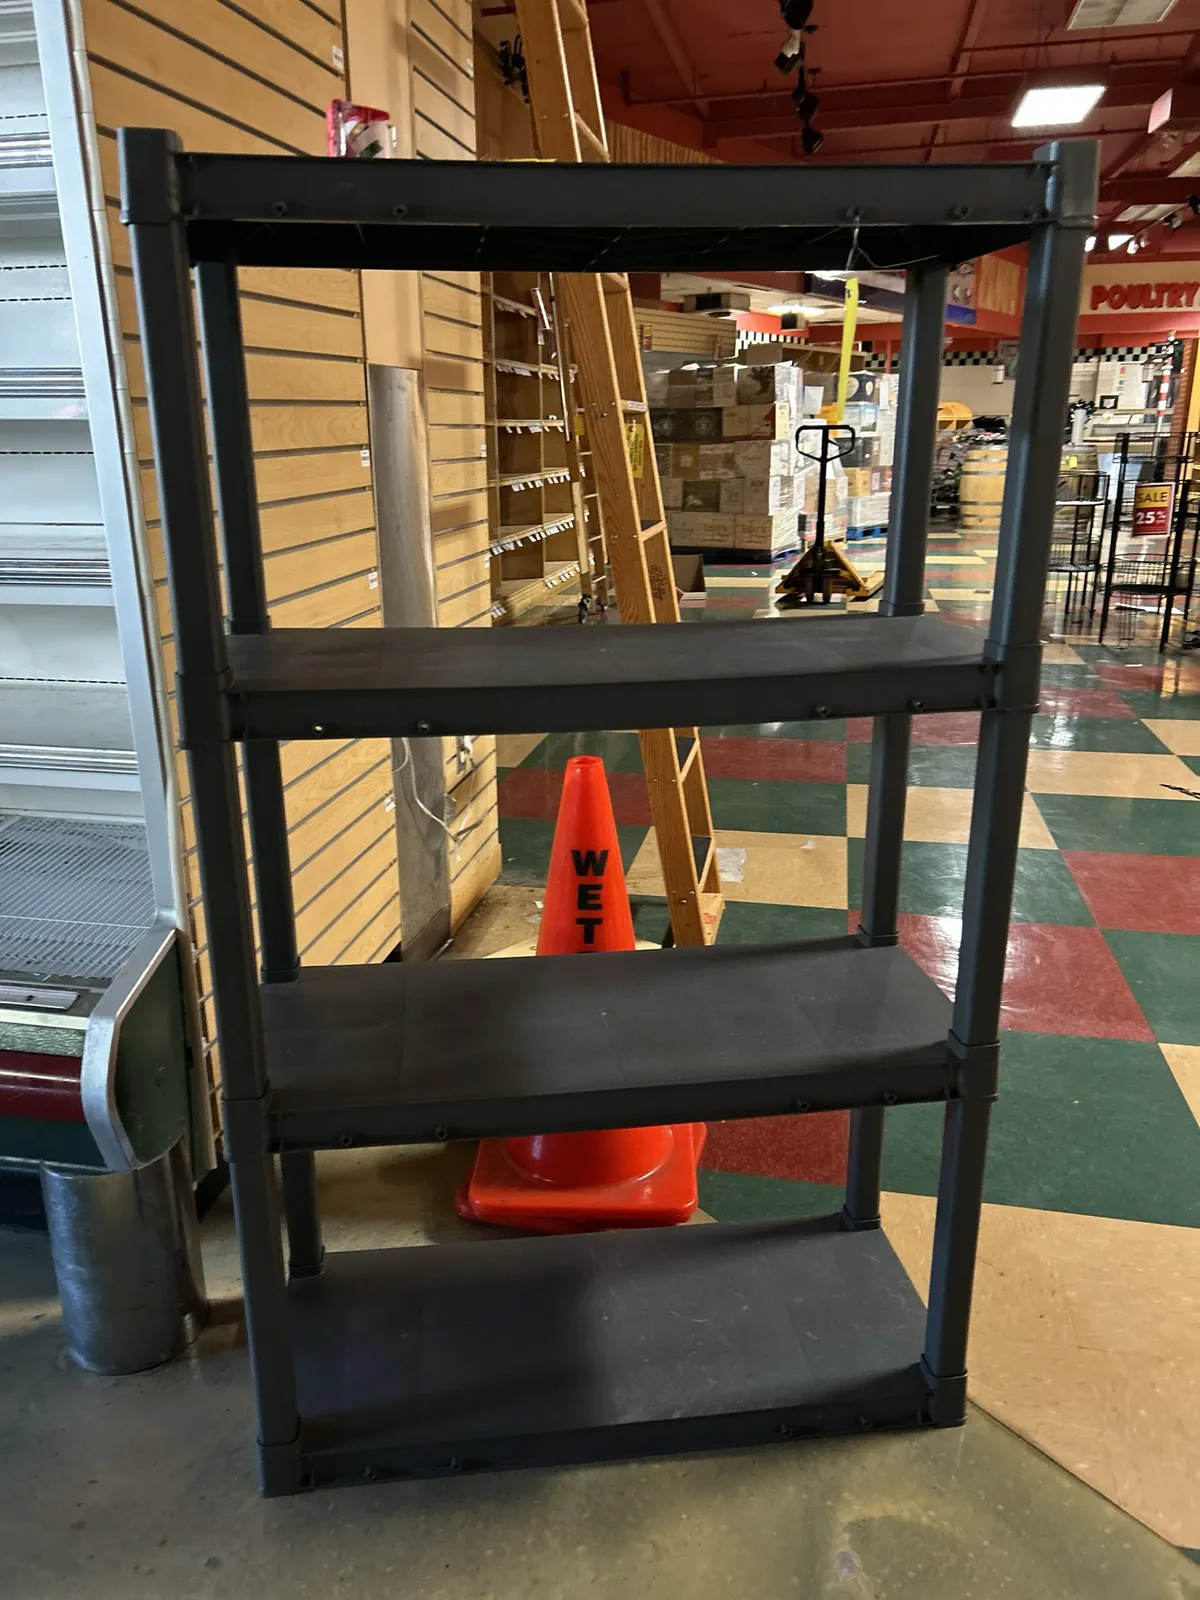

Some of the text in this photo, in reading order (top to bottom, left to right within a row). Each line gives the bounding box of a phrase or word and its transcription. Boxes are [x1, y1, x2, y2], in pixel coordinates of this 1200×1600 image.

[1090, 282, 1200, 311] POULTRY
[1137, 491, 1168, 503] SALE
[571, 849, 609, 945] WET
